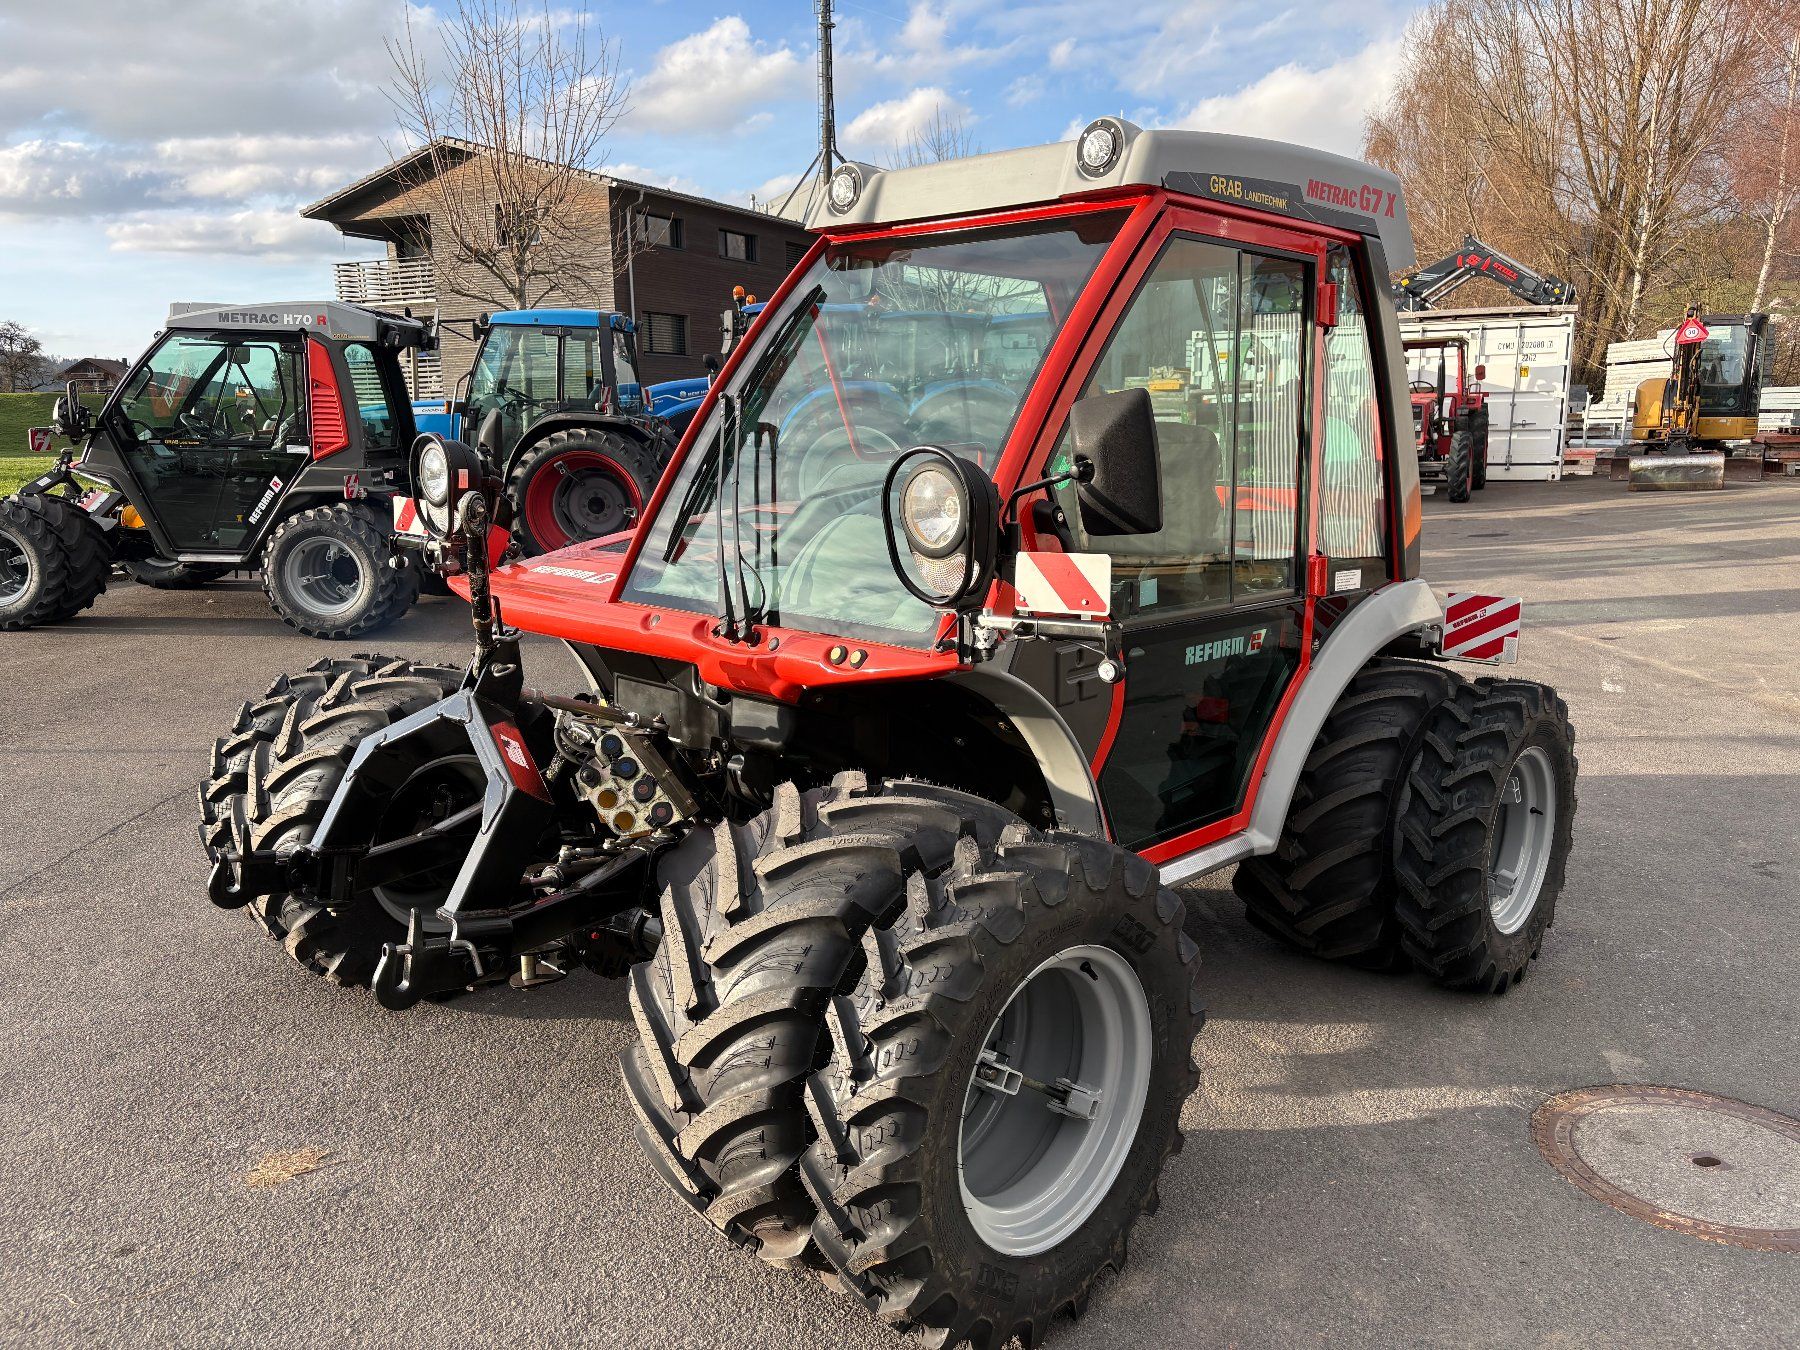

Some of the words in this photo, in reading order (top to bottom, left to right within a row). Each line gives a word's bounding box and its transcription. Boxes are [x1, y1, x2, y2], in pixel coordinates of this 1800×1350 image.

[1209, 175, 1243, 199] GRAB
[1244, 189, 1289, 210] LANDTECHNIK
[1306, 178, 1358, 209] METRAC
[1359, 184, 1383, 214] G7
[1384, 192, 1397, 219] X
[218, 312, 279, 325] METRAC
[283, 314, 313, 326] H70
[248, 488, 275, 525] REFORM
[1185, 636, 1245, 666] REFORM
